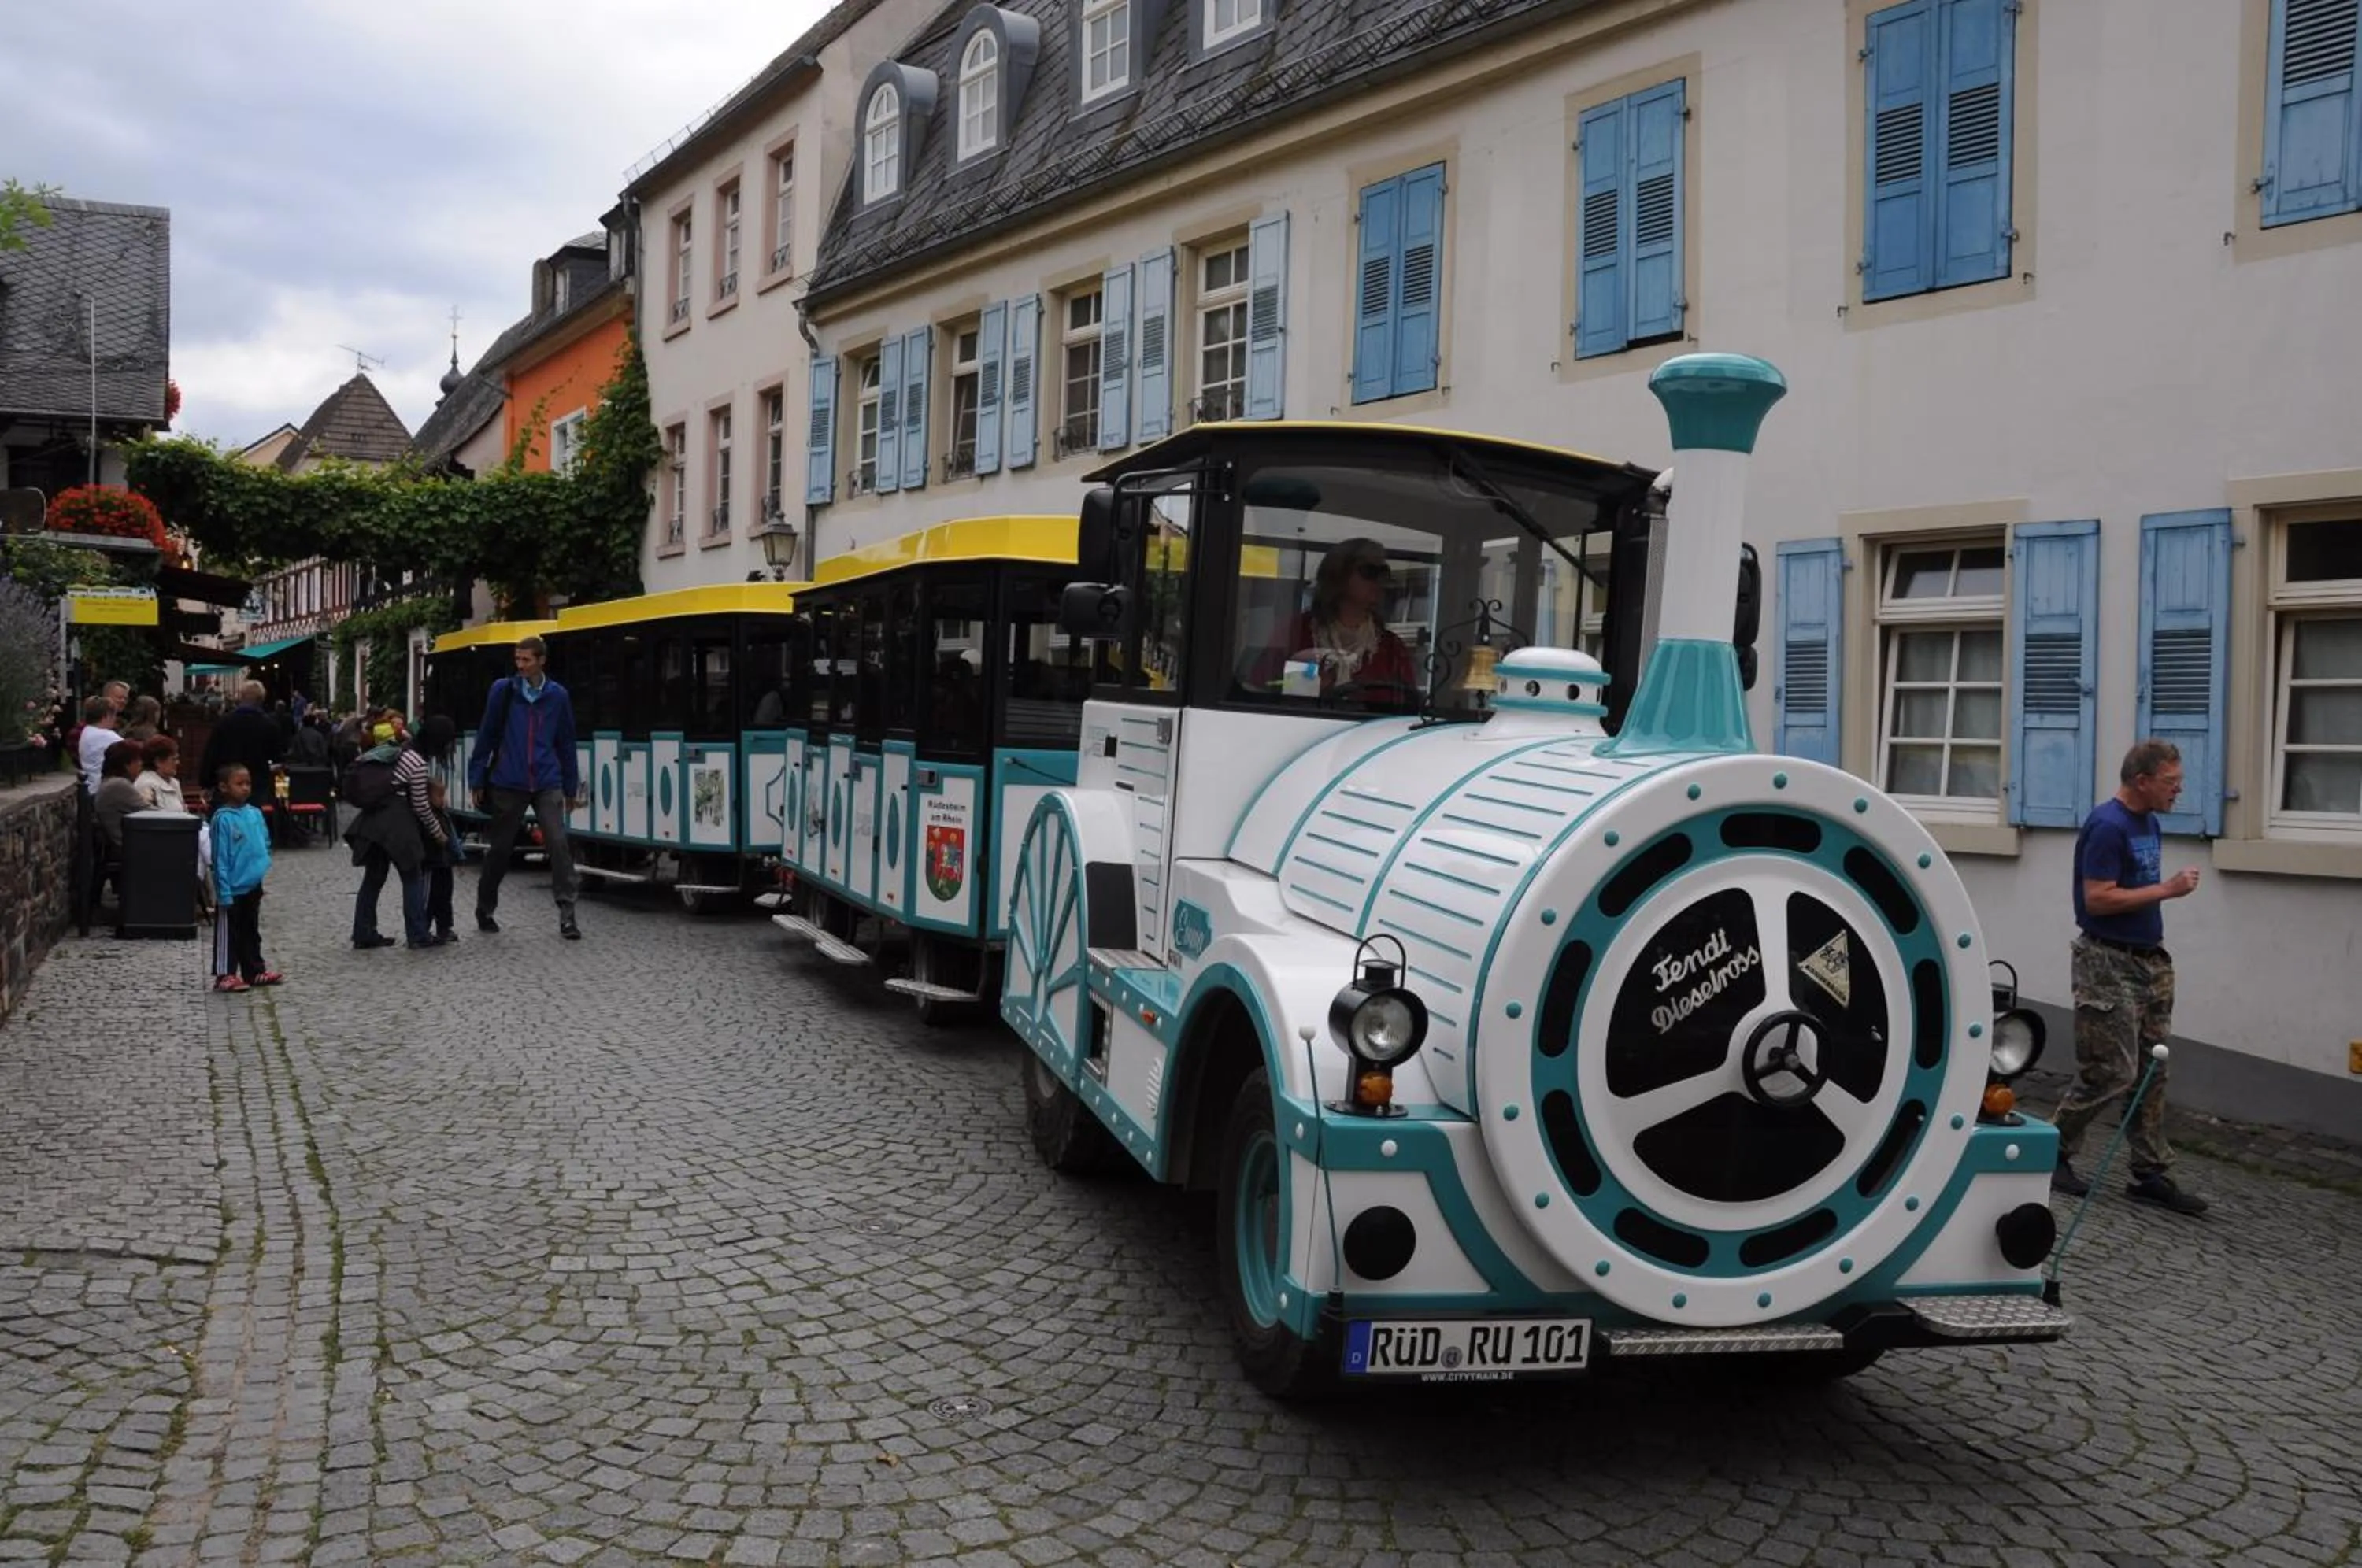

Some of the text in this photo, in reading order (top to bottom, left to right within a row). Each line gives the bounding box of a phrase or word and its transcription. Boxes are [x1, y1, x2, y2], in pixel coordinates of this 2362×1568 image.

[1652, 927, 1731, 992] Fendt
[1651, 945, 1760, 1035] Dieselross
[1351, 1353, 1361, 1364] D
[1467, 1326, 1515, 1366] RU
[1520, 1325, 1583, 1364] 101
